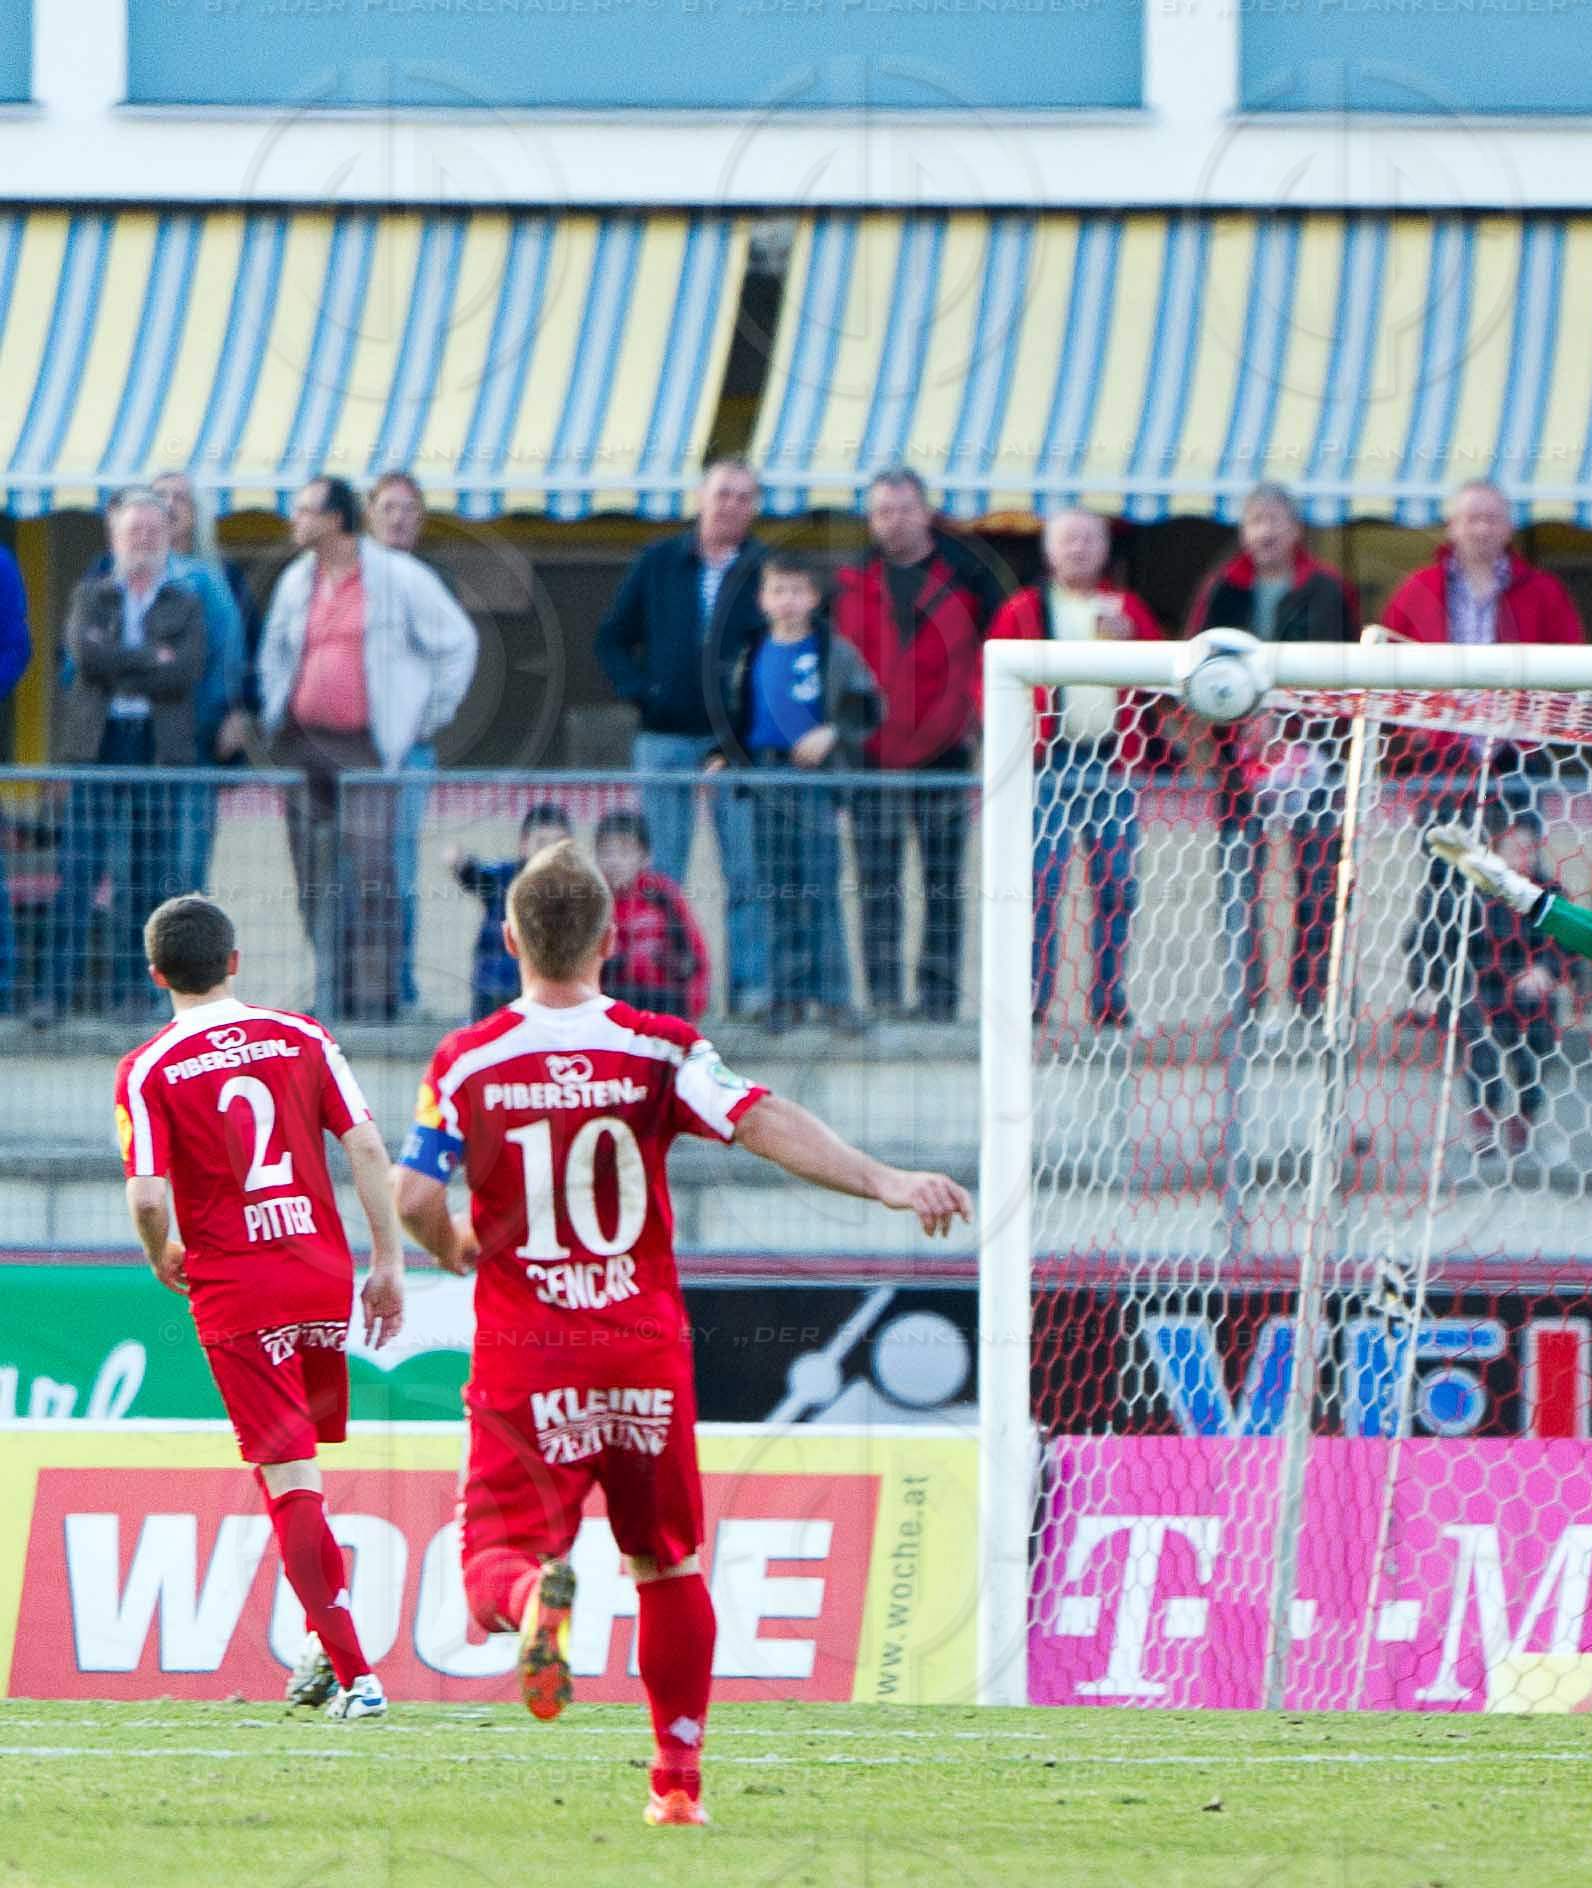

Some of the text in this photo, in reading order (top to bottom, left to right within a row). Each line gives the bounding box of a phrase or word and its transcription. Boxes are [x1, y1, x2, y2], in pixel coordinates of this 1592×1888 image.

[216, 1075, 294, 1192] 2
[505, 1116, 649, 1262] 10
[243, 1196, 318, 1242] PITTER
[529, 1386, 675, 1430] KLEINE
[62, 1514, 834, 1679] WOCHE
